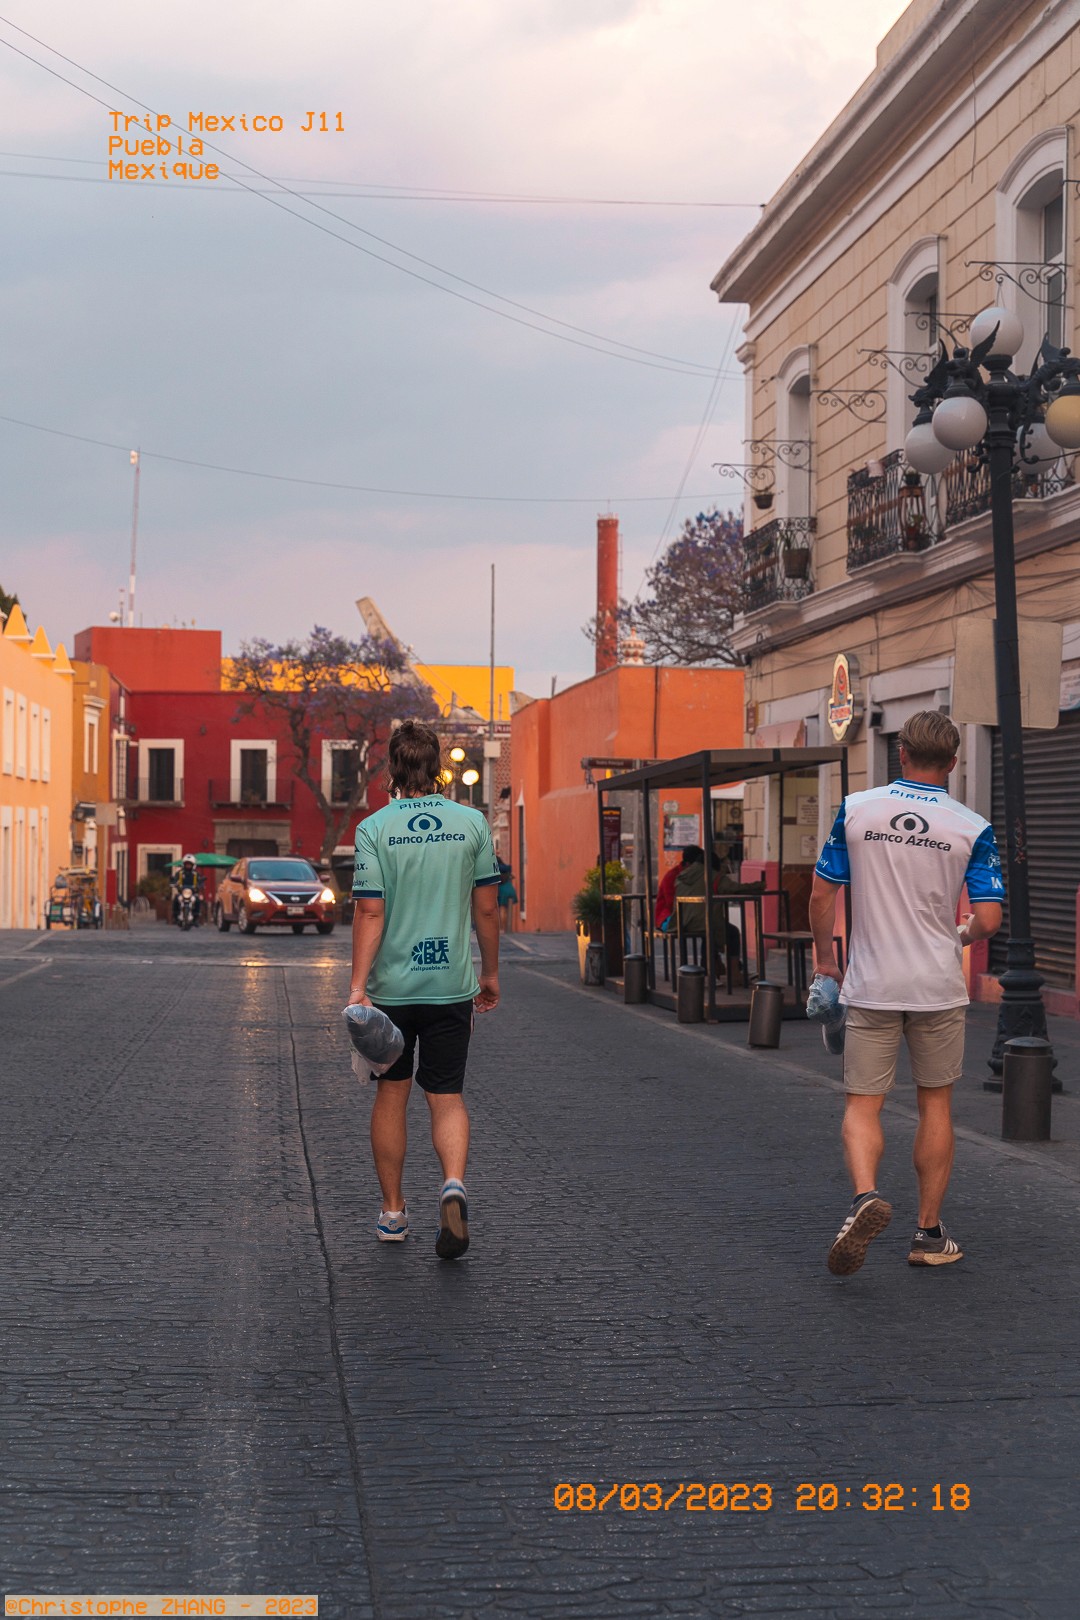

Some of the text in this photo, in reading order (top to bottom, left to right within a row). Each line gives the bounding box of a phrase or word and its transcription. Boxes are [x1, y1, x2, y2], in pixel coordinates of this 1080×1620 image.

[889, 789, 939, 803] PIRMA
[399, 801, 444, 810] PIRMA
[388, 832, 466, 847] Banco Azteca
[863, 830, 952, 852] Banco Azteca
